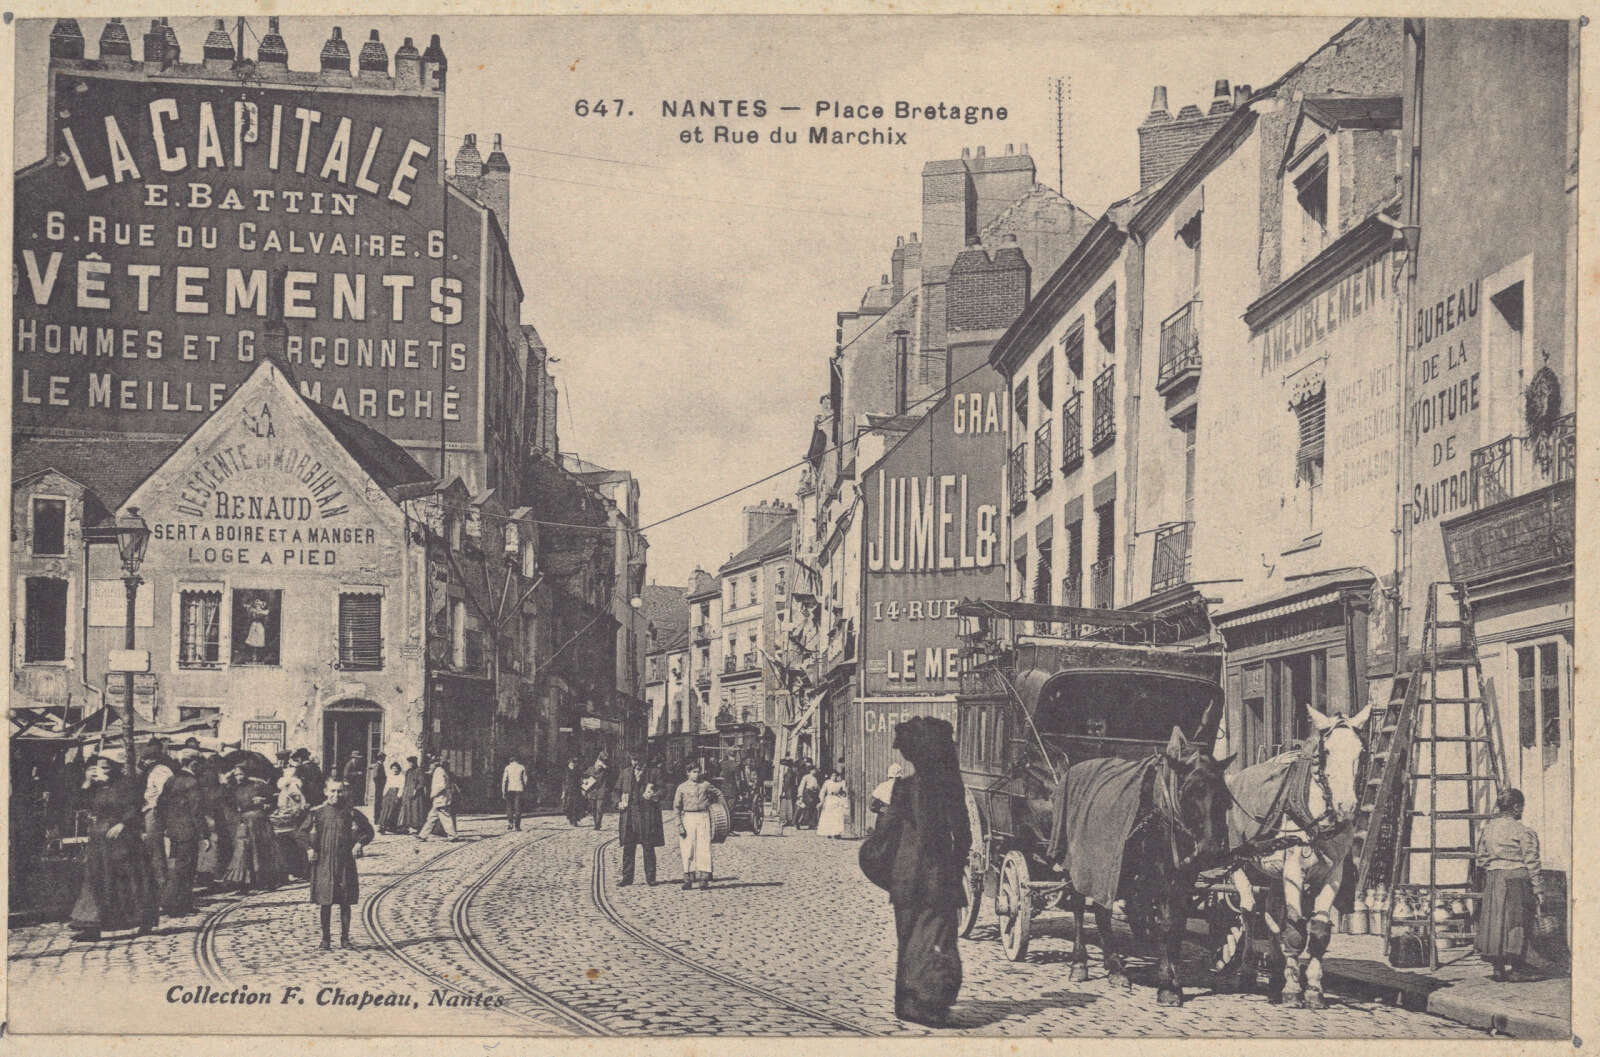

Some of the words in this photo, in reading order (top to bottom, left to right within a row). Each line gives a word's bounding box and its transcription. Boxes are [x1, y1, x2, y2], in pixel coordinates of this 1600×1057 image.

[62, 114, 142, 192] LA
[149, 98, 431, 206] CAPITALE
[88, 216, 156, 246] RUE
[177, 225, 218, 250] DU
[238, 222, 407, 257] CALVAIRE
[22, 248, 464, 325] VÊTEMENTS
[1416, 277, 1480, 351] BUREAU
[18, 318, 164, 360] HOMMES
[183, 335, 222, 361] ET
[237, 329, 467, 372] GRÇONNETS
[1422, 353, 1440, 385] DE
[1447, 339, 1468, 370] LA
[22, 369, 71, 406] LE
[88, 373, 233, 413] MEILLE
[300, 380, 461, 421] MARCHÉ
[1412, 372, 1480, 447] VOITURE
[255, 421, 277, 438] LA
[1432, 435, 1456, 468] DE
[177, 443, 251, 518] DESCENTE
[273, 447, 350, 519] MORBIHAN
[214, 490, 312, 521] RENAUD
[154, 524, 198, 542] SERT
[216, 525, 264, 542] BOIRE
[269, 529, 287, 542] ET
[308, 527, 375, 544] MANGER
[868, 468, 975, 571] JUMEL
[976, 503, 998, 567] &
[189, 547, 250, 564] LOGE
[283, 549, 337, 565] PIED
[887, 649, 917, 680] LE
[925, 647, 960, 680] ME
